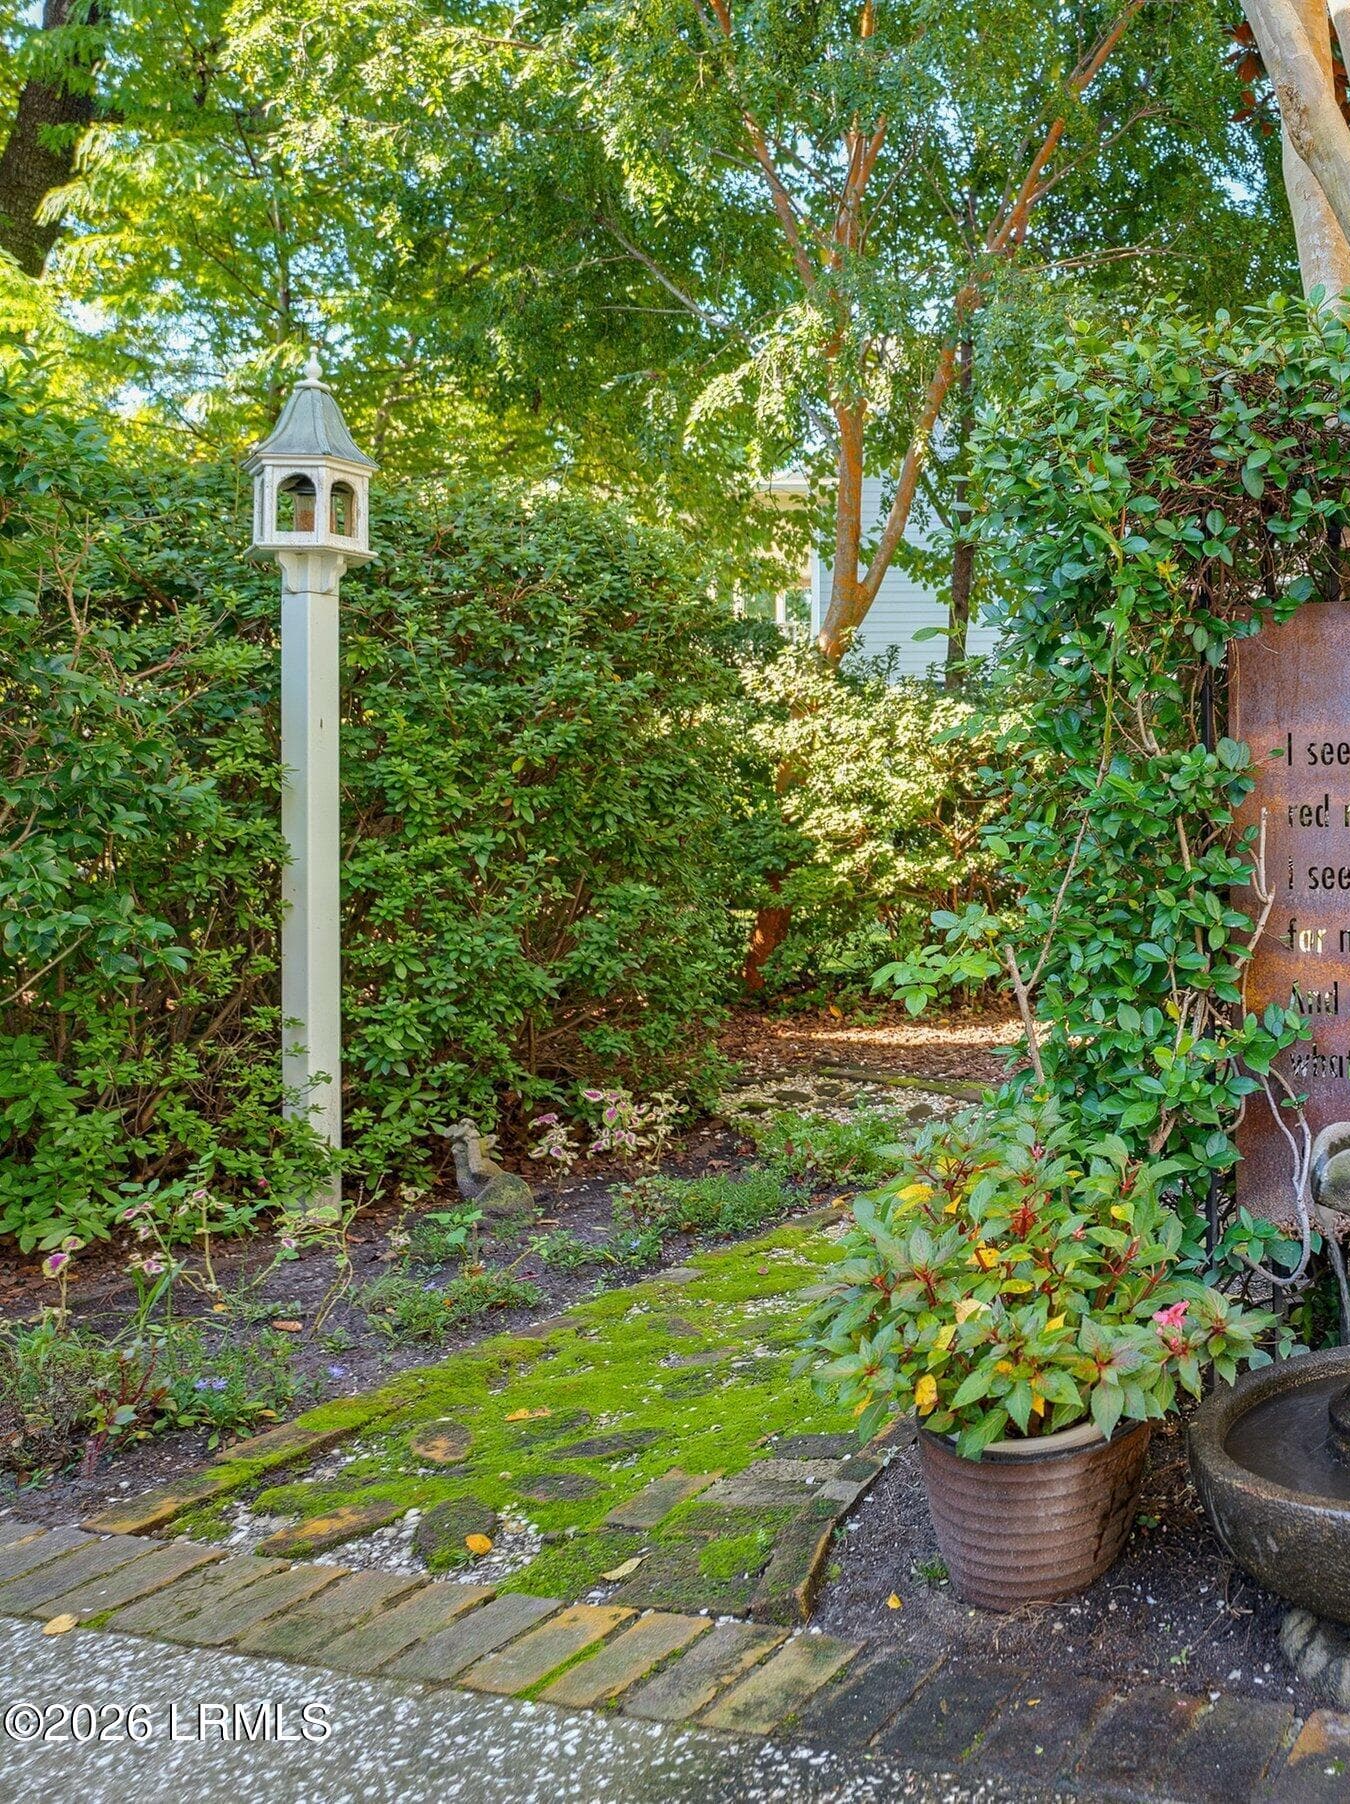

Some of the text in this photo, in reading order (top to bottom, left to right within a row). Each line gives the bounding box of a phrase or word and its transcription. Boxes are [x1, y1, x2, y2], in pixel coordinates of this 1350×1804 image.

[1286, 732, 1293, 768] I
[1306, 738, 1350, 767] see
[1287, 794, 1330, 828] red
[1287, 918, 1327, 956] for
[1290, 979, 1339, 1017] And
